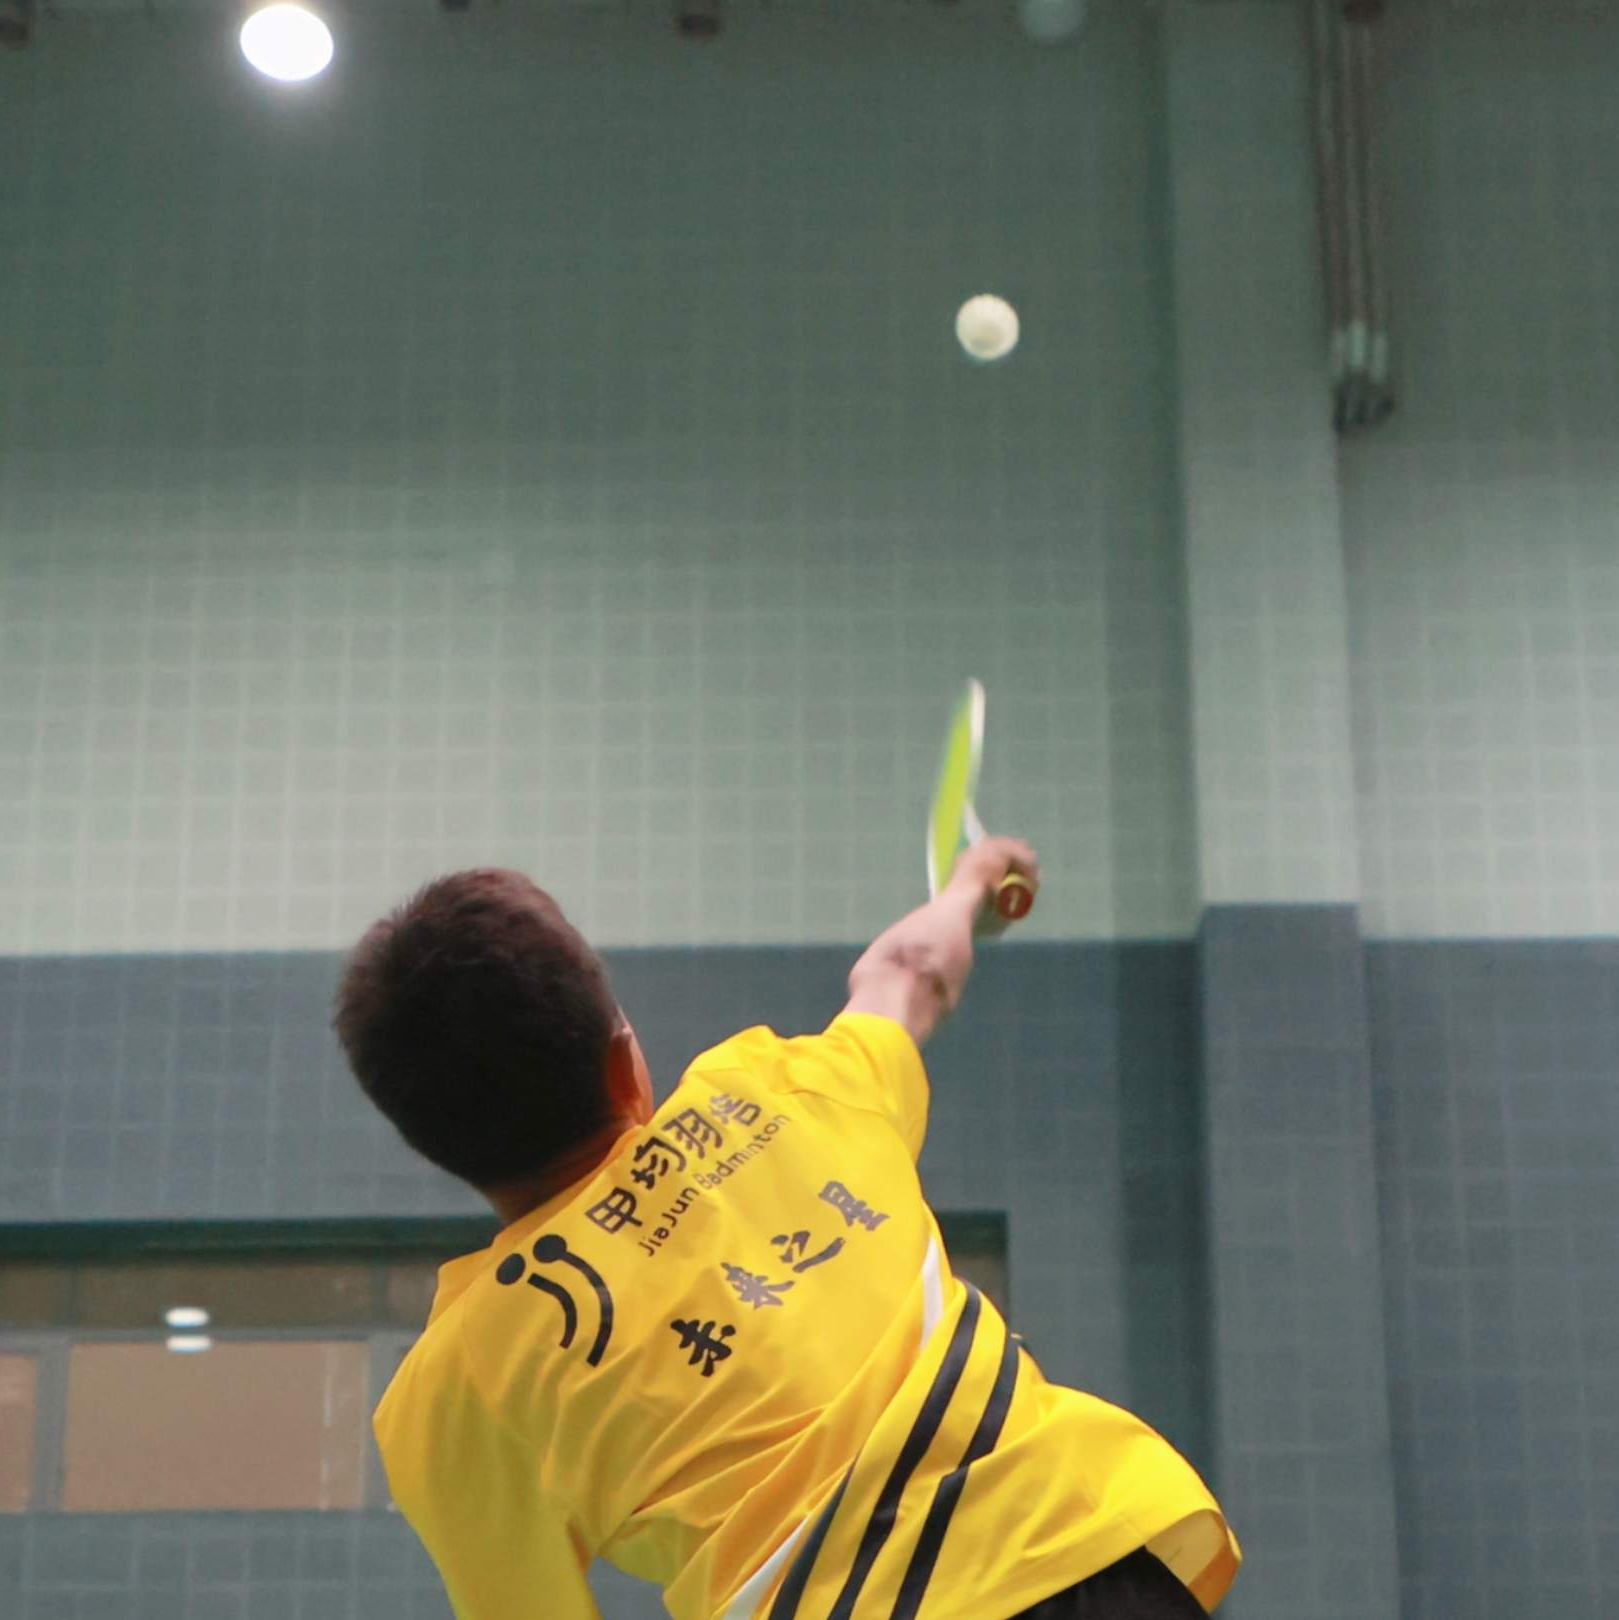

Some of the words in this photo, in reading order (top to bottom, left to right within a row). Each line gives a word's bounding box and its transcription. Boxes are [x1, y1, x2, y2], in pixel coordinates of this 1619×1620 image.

[692, 1114, 792, 1190] Badminton
[670, 1180, 890, 1378] 未来之星
